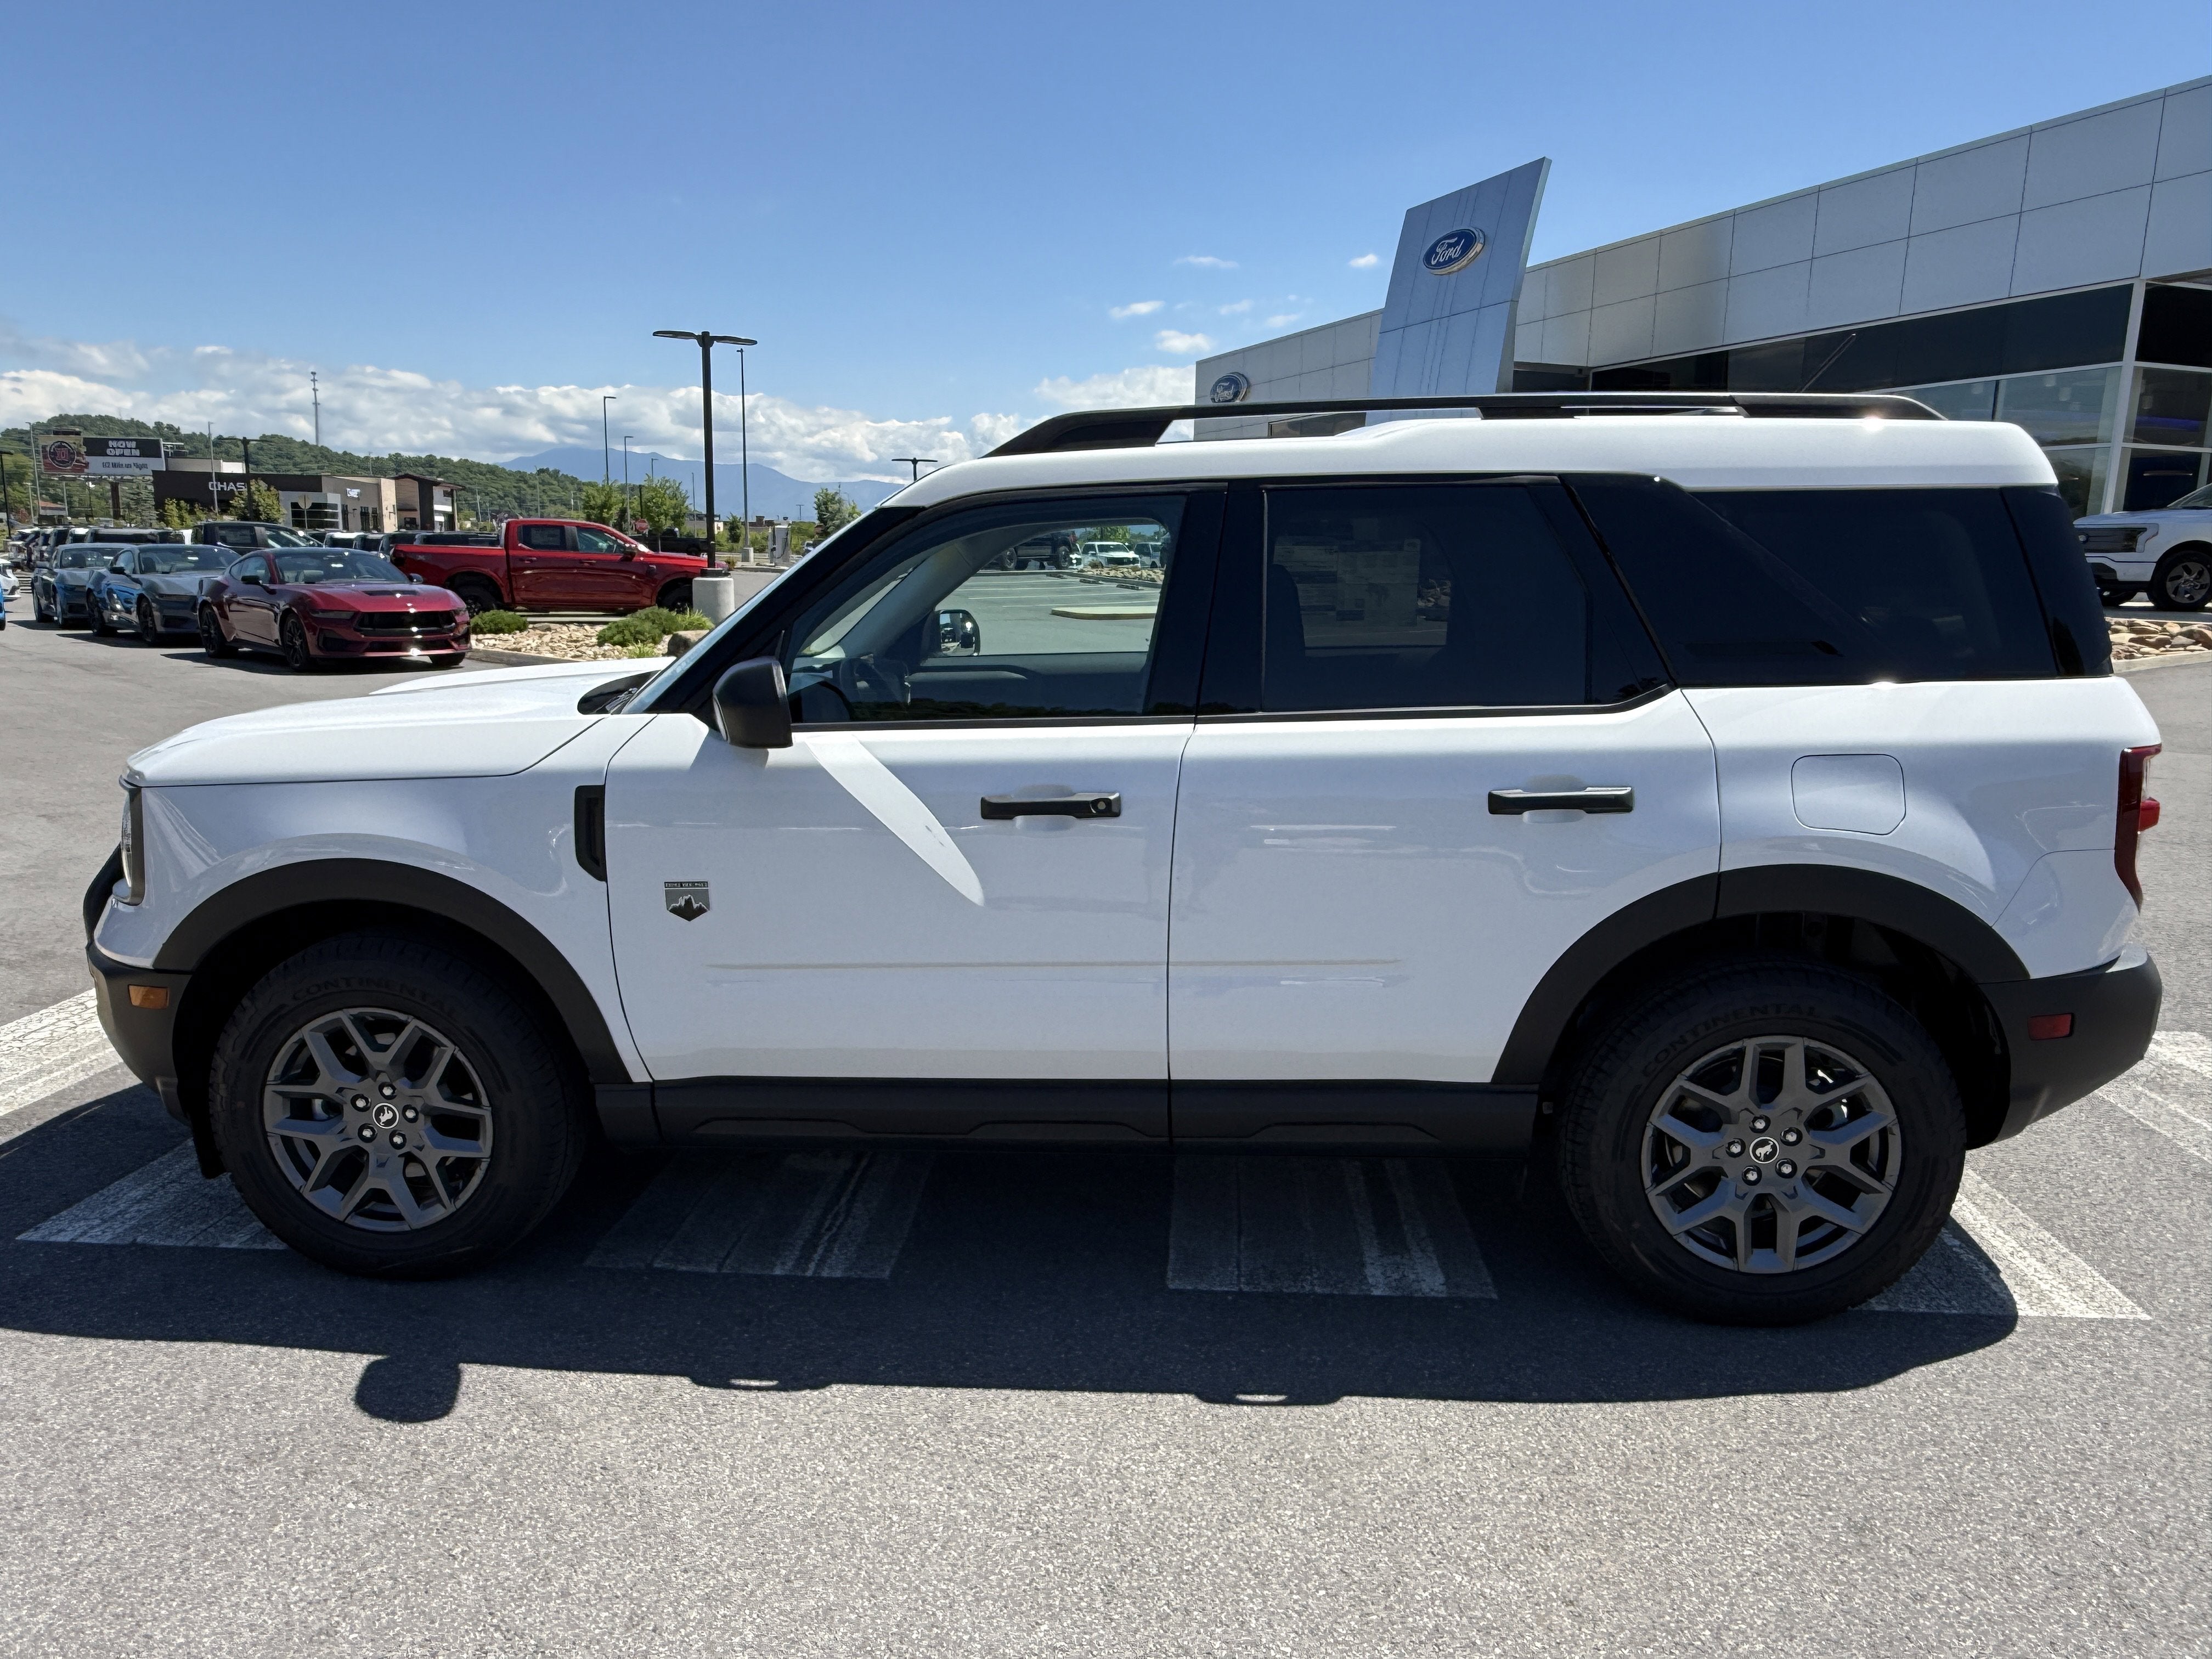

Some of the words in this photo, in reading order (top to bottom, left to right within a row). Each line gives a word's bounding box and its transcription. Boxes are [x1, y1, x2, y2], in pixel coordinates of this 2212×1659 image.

[1431, 237, 1465, 265] Ford
[106, 448, 140, 456] OPEN
[108, 440, 136, 448] NOW
[1642, 1002, 1818, 1078] CONTINENTAL
